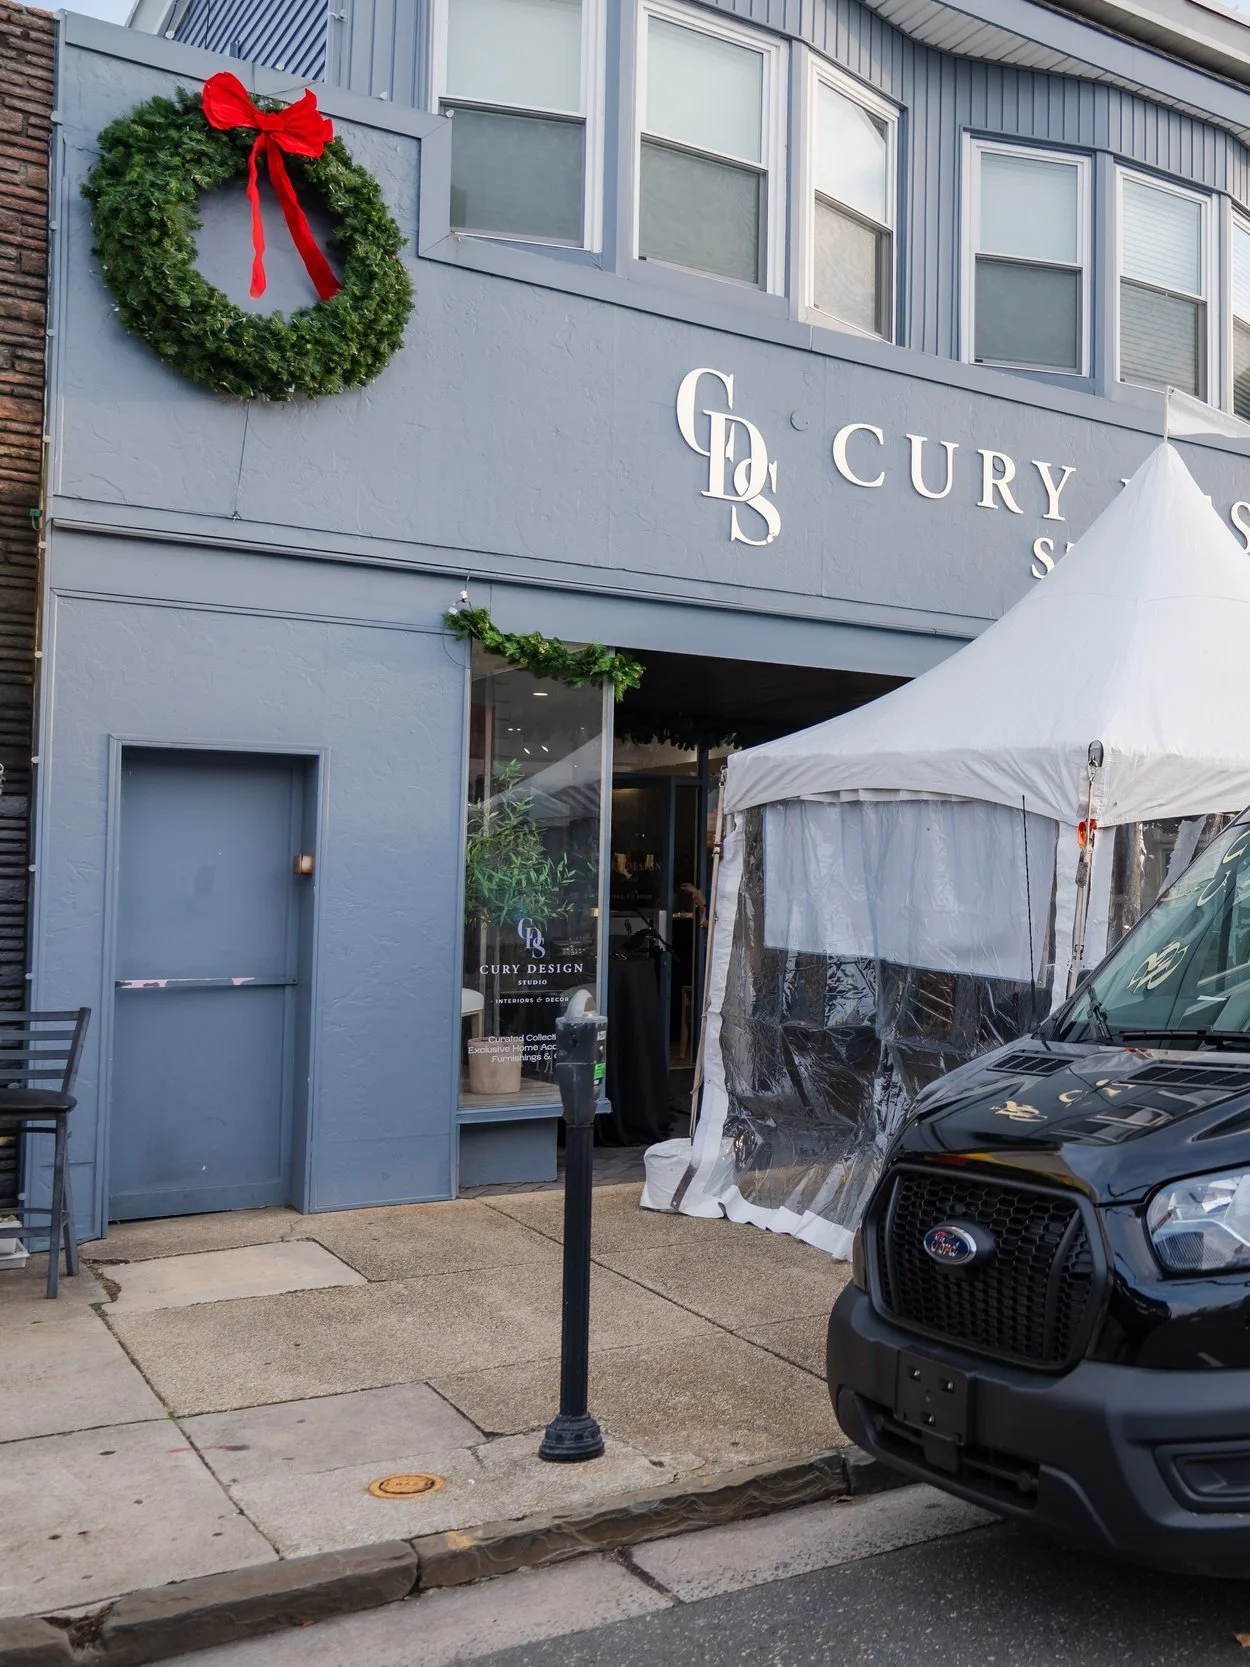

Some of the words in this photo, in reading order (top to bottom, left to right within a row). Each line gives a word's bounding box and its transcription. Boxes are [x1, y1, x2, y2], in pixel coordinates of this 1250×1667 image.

[832, 423, 1076, 521] CURY
[480, 964, 520, 975] CURY
[527, 963, 584, 974] DESIGN
[488, 1034, 524, 1043] Curated
[526, 1033, 556, 1042] Collecti
[468, 1045, 510, 1054] Exclusive
[513, 1044, 538, 1052] Home
[492, 1054, 541, 1062] Furnishings
[931, 1231, 960, 1257] Ford
